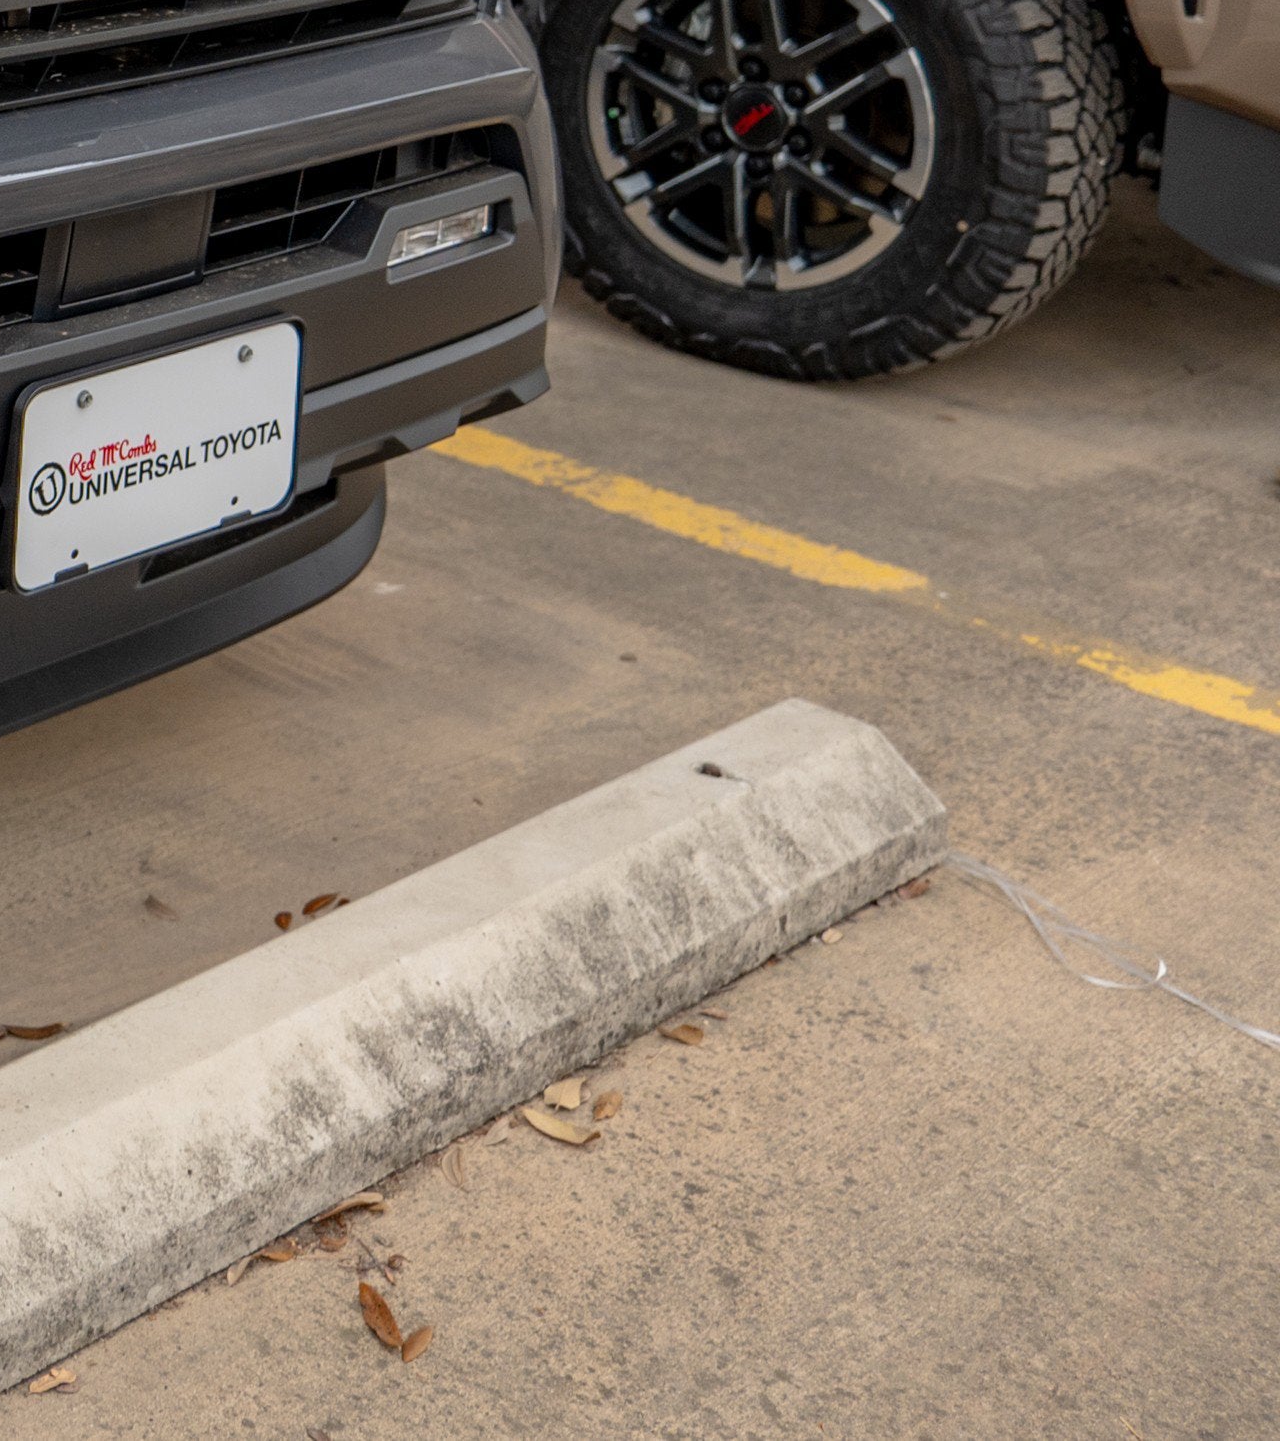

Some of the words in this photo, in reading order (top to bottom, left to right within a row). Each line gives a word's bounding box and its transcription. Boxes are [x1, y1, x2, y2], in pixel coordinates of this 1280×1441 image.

[69, 449, 97, 481] Red
[99, 434, 157, 466] McCombs
[69, 446, 197, 505] UNIVERSAL
[200, 419, 282, 463] TOYOTA
